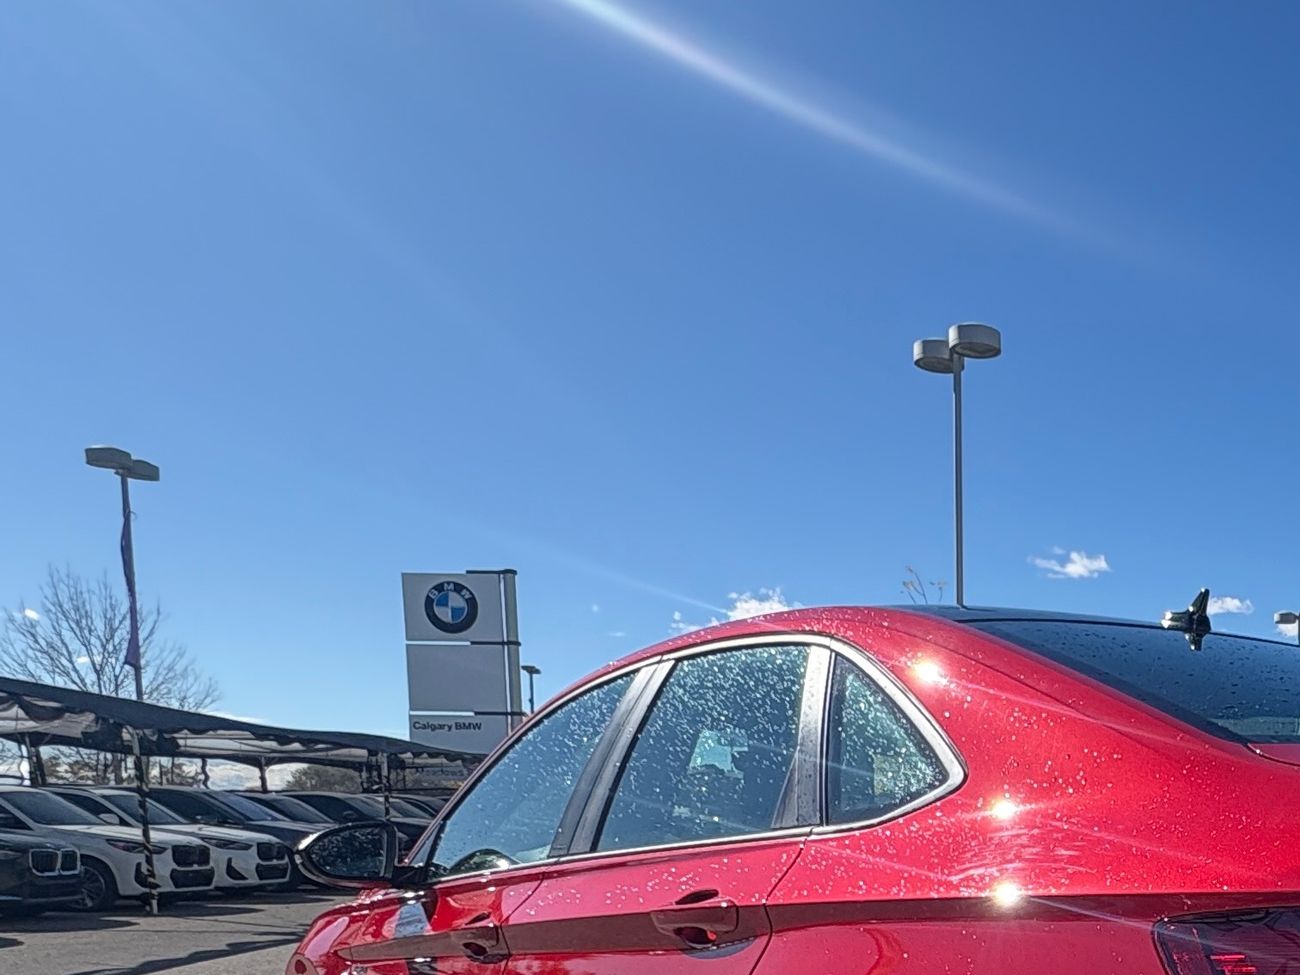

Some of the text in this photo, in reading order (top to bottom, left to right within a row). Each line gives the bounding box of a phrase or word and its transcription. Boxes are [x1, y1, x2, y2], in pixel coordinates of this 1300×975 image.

[428, 582, 472, 600] BMW
[413, 721, 482, 732] Calgary BMW
